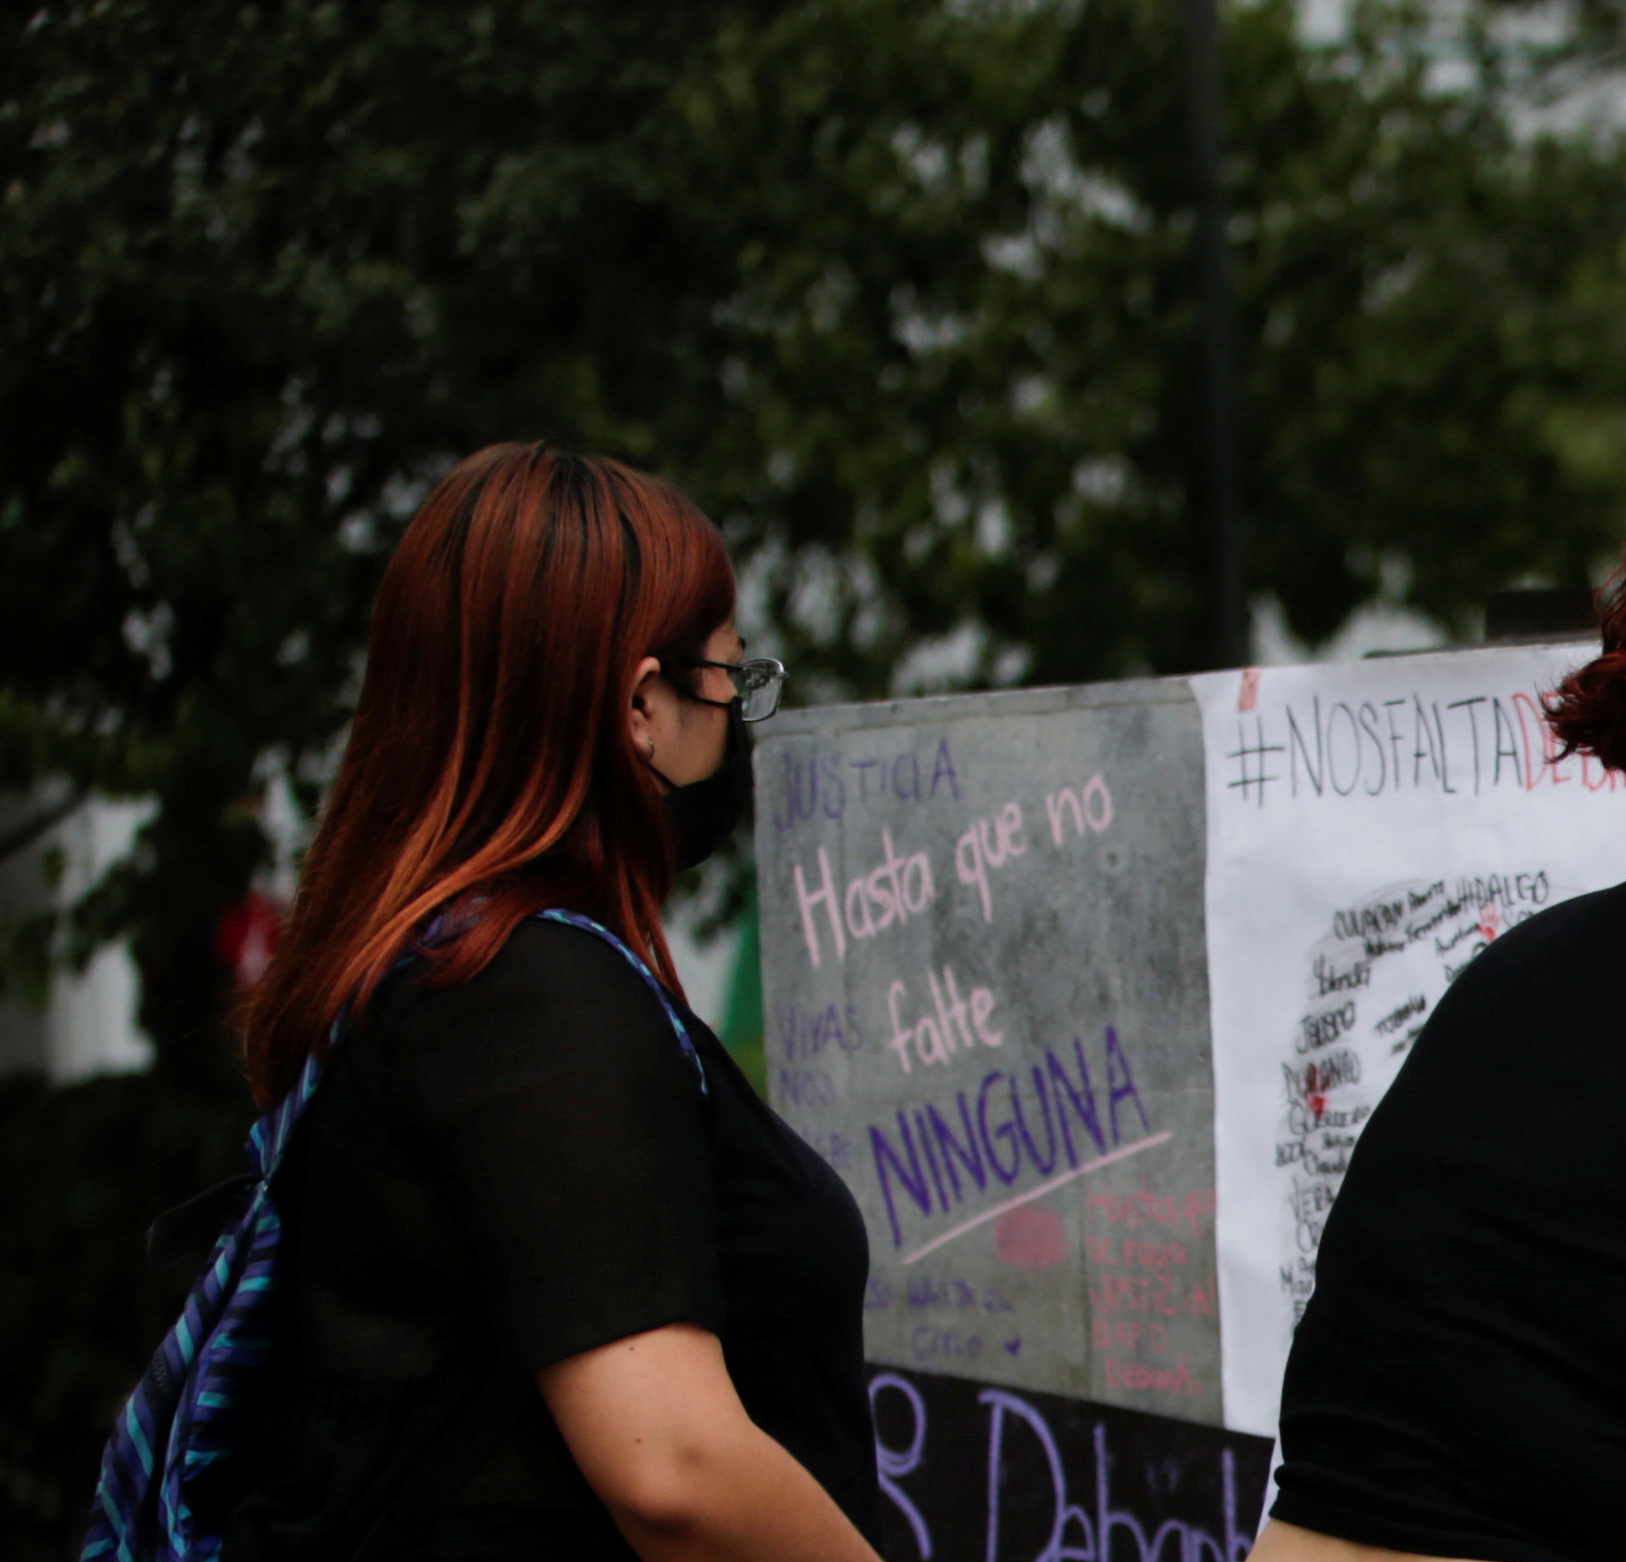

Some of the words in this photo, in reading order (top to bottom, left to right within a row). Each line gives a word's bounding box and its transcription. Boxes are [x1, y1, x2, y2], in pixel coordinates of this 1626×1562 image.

[773, 736, 963, 834] JUSTICIA
[794, 825, 936, 967] Hasta
[956, 802, 1027, 924] que
[1047, 773, 1115, 848] no
[888, 965, 1004, 1074] falte
[868, 1023, 1151, 1250] NINGUNA
